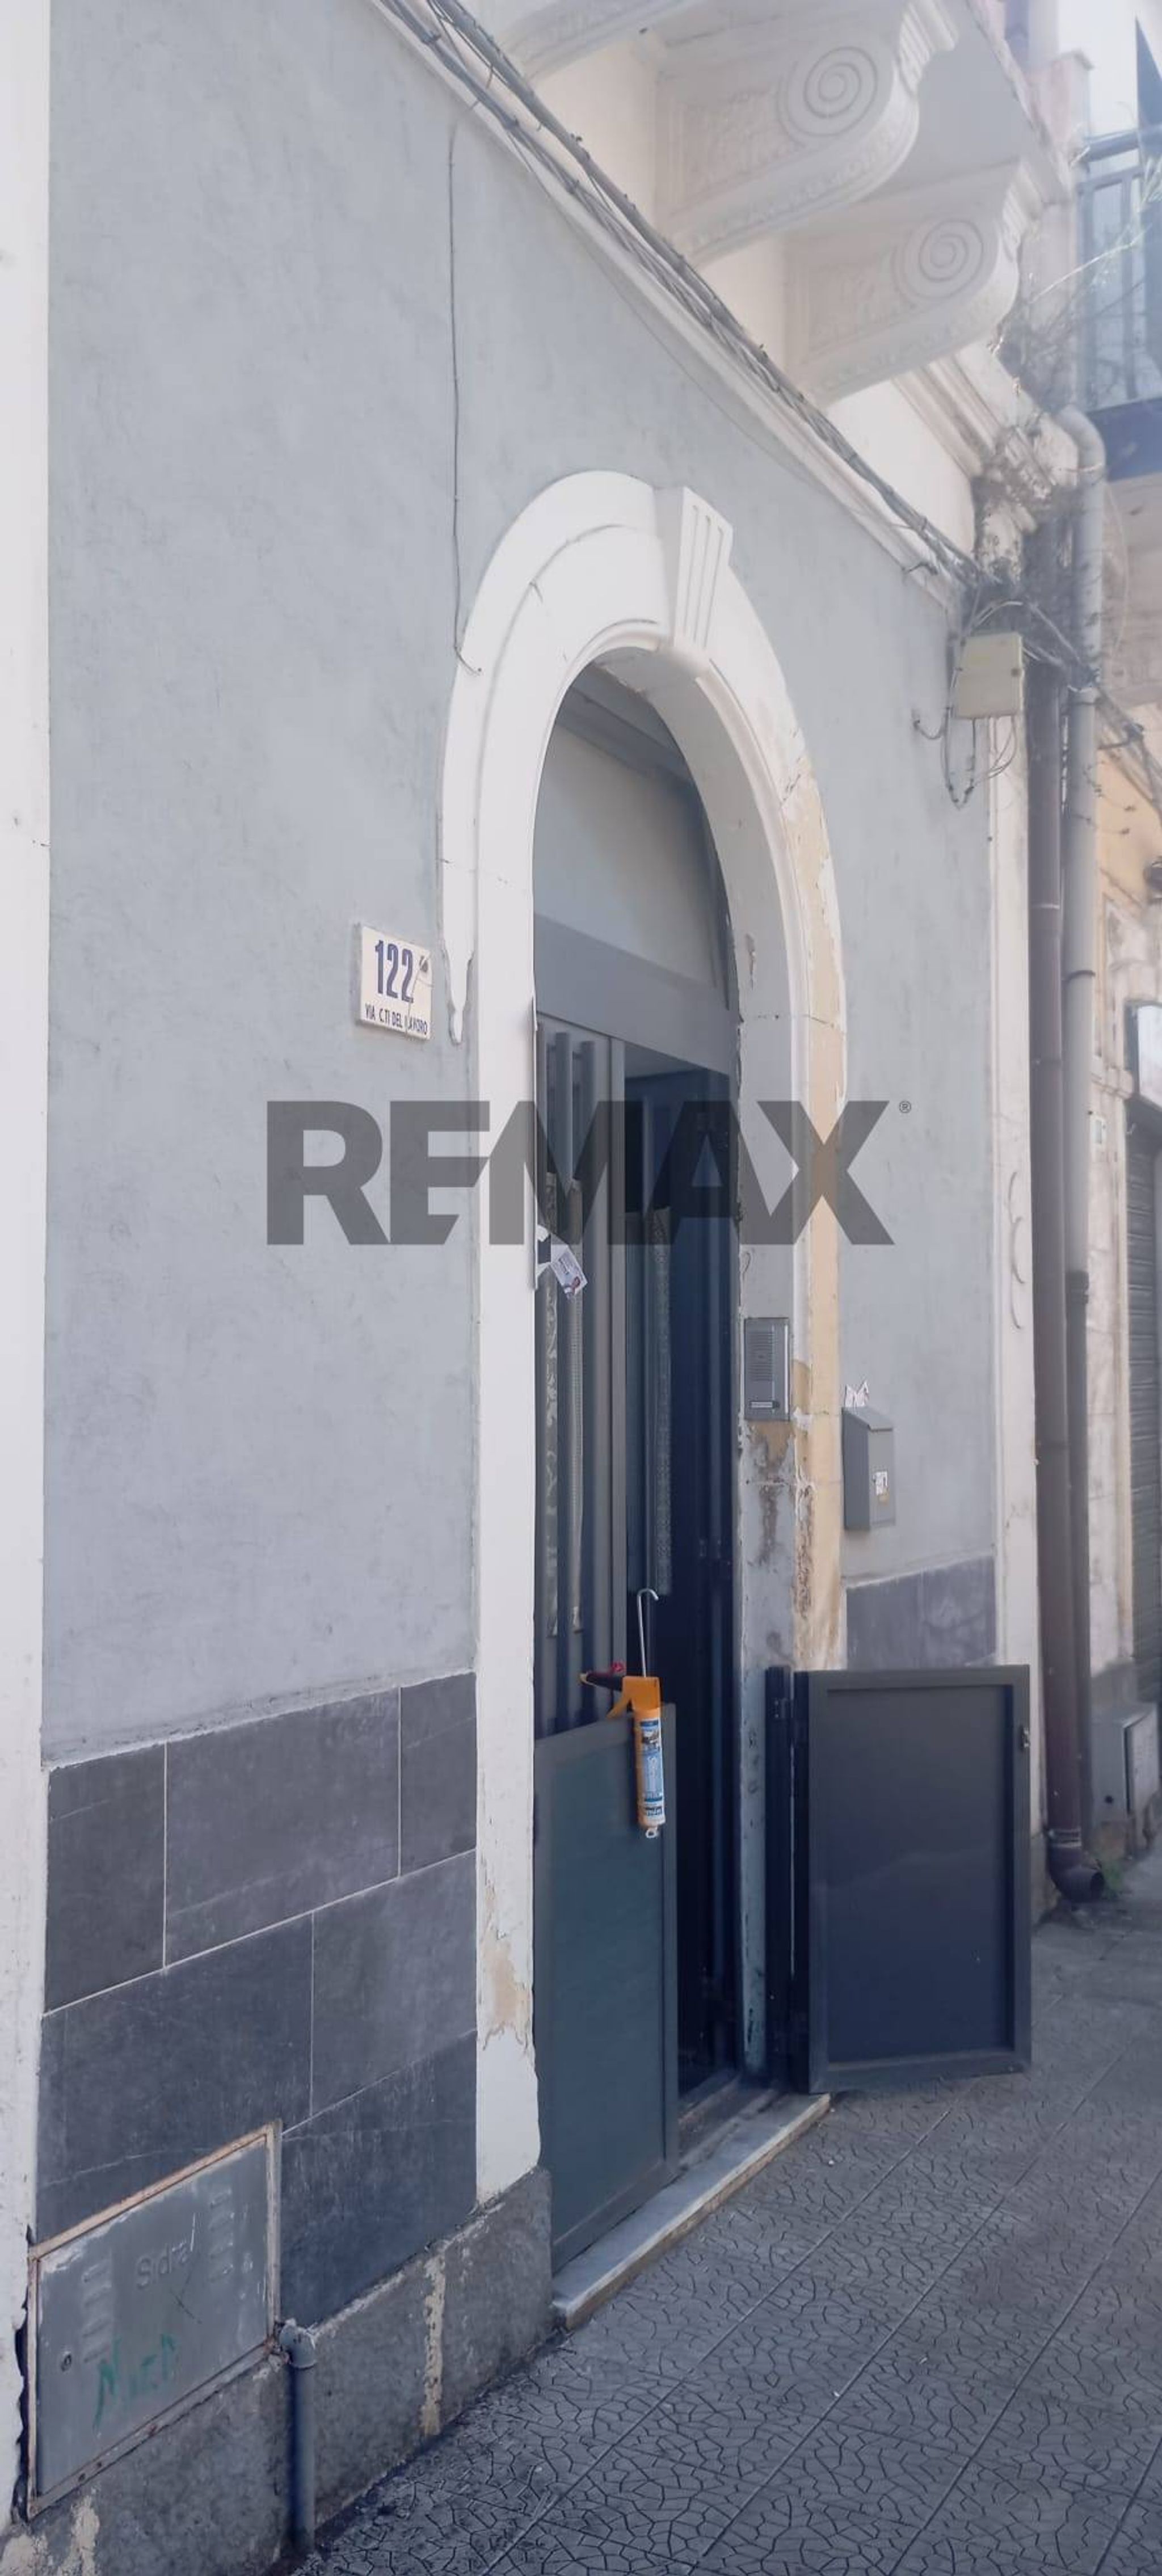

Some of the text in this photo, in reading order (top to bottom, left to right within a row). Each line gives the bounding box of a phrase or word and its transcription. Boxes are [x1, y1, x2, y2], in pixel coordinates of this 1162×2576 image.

[375, 940, 414, 1003] 122
[365, 1002, 376, 1021] VIA
[392, 1011, 403, 1028] DEL
